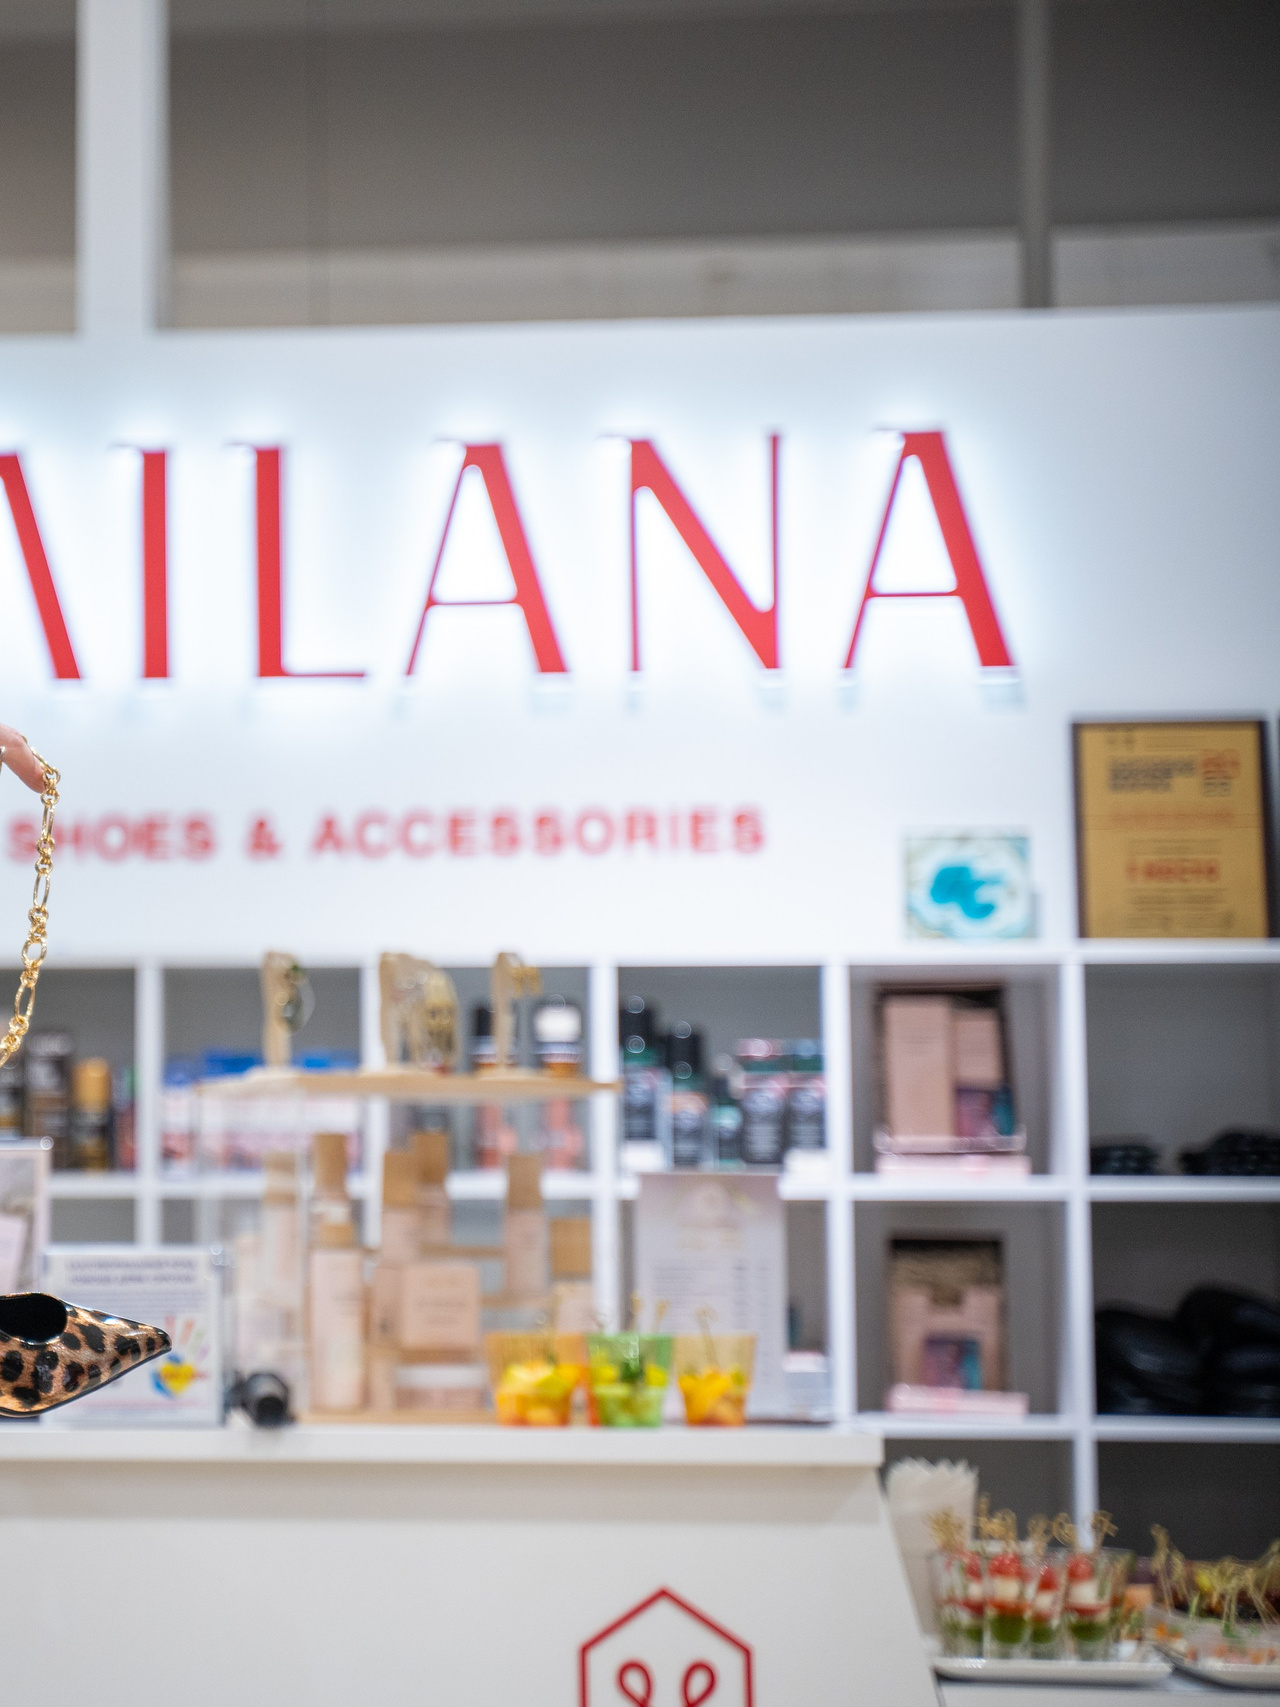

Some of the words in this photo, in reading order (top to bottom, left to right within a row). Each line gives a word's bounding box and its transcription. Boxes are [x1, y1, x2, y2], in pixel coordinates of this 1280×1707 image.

[8, 811, 217, 862] SHOES
[246, 812, 283, 861] &
[312, 805, 765, 858] ACCESSORIES
